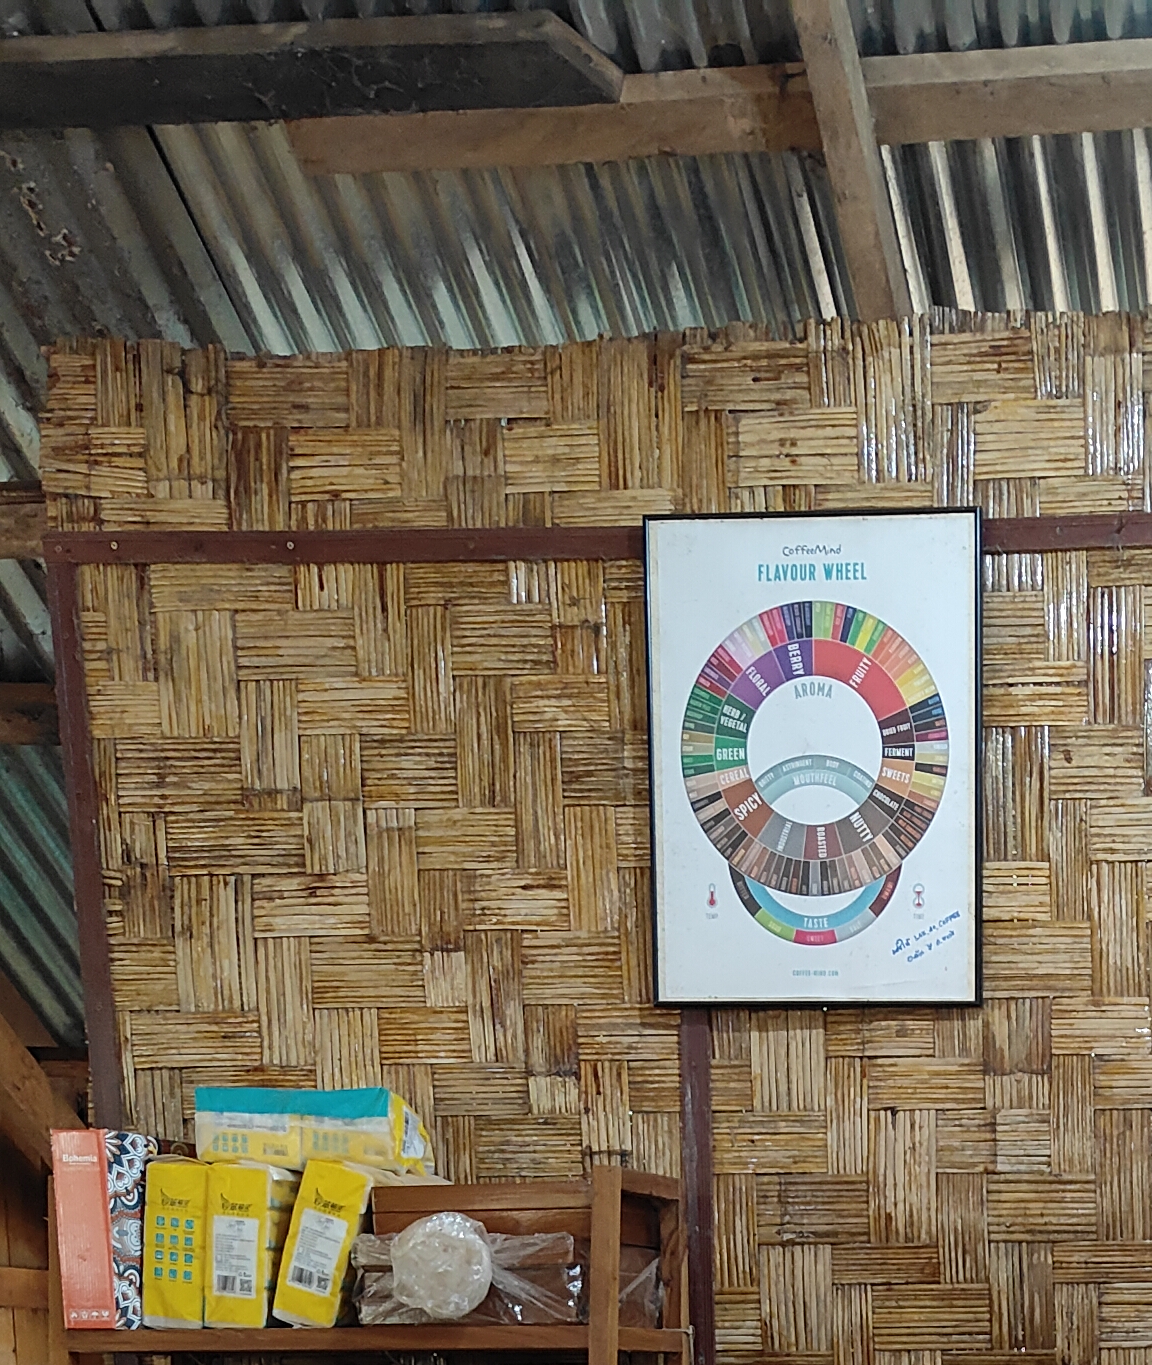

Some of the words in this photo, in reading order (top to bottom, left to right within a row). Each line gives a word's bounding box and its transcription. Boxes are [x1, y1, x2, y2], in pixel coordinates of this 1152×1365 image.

[782, 544, 842, 557] CoffeeMind
[758, 563, 816, 582] FLAVOUR
[823, 561, 867, 581] WHEEL
[788, 643, 805, 676] BERRY
[745, 666, 771, 697] FLORAL
[849, 657, 872, 689] FRUITY
[793, 681, 833, 700] AROMA
[720, 715, 747, 733] VEGETAL
[716, 747, 745, 761] GREEN
[884, 747, 913, 757] FERMENT
[719, 768, 750, 785] CEREAL
[793, 771, 837, 786] MOUTHFEEL
[881, 767, 911, 784] SWEETS
[734, 792, 763, 821] SPICY
[873, 789, 900, 811] CHOCOLATE
[849, 812, 874, 842] NUTTY
[816, 826, 828, 858] ROASTED
[803, 917, 829, 929] TASTE
[62, 1153, 98, 1162] Bohemia
